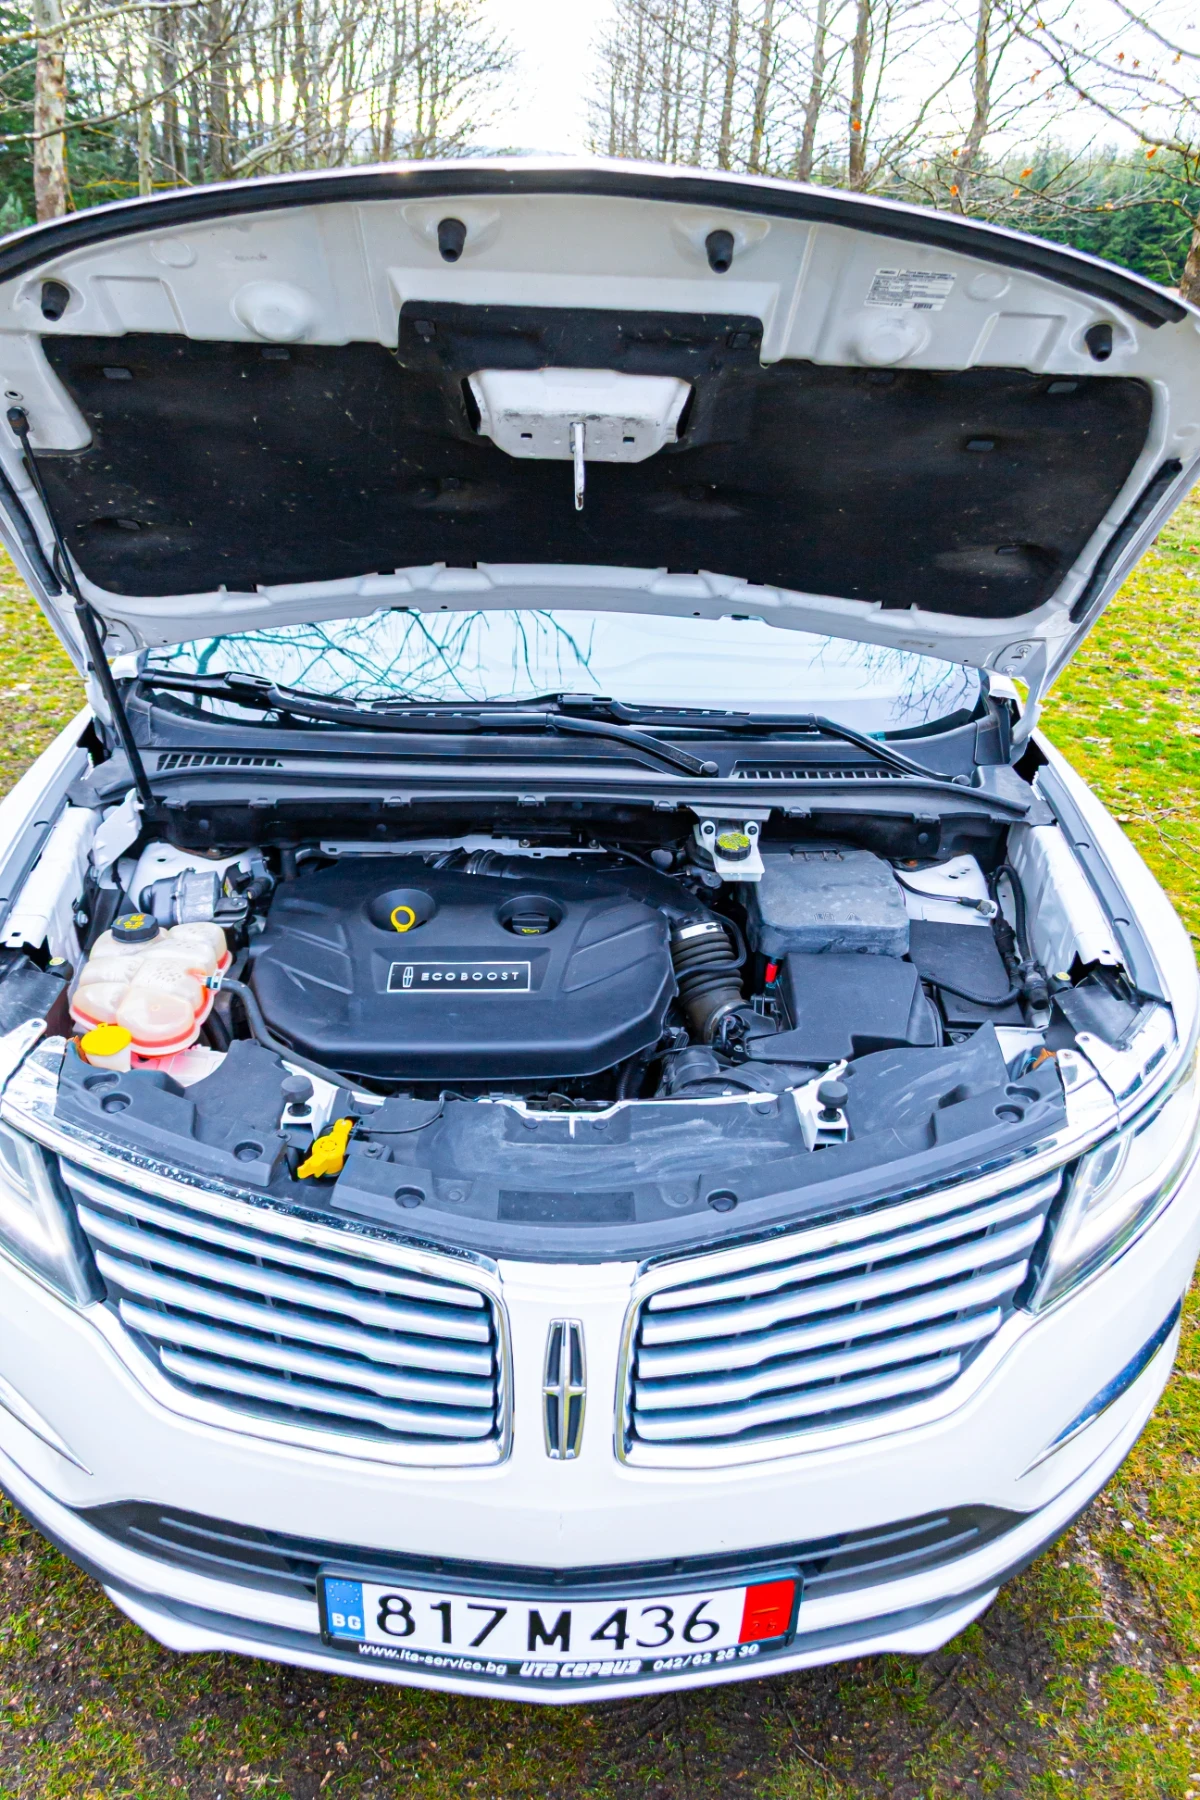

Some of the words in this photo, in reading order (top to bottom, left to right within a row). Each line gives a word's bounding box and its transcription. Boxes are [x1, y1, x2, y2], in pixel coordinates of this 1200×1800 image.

[421, 971, 519, 981] ECOBOOST
[331, 1612, 362, 1631] BG
[376, 1593, 508, 1647] 817
[527, 1607, 572, 1652] M
[590, 1598, 720, 1650] 436
[358, 1643, 507, 1676] www.ita-service.bg
[653, 1652, 712, 1672] 042/62
[739, 1643, 760, 1657] 30
